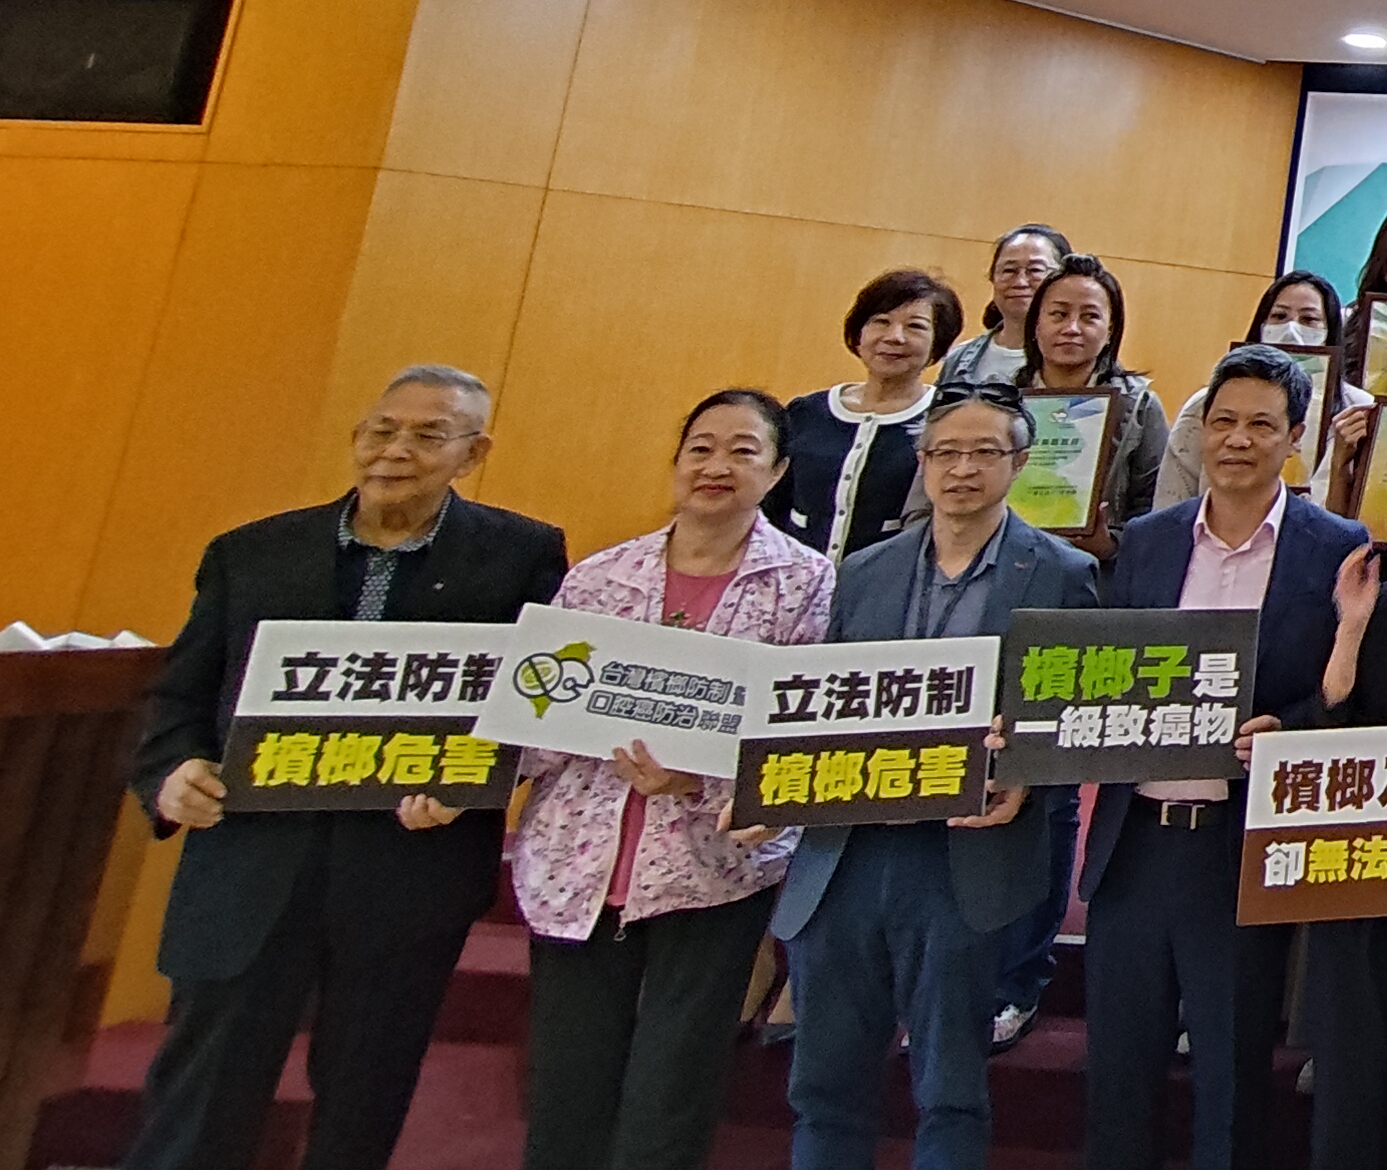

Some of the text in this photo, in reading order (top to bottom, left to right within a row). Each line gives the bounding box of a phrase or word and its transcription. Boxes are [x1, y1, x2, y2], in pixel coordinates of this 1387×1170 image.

[271, 650, 503, 704] 立法防制
[768, 665, 976, 725] 立法防制
[1020, 645, 1241, 704] 檳榔子是
[1014, 703, 1238, 749] 一級致癌物
[251, 732, 499, 788] 檳榔危害
[759, 744, 969, 806] 檳榔危害
